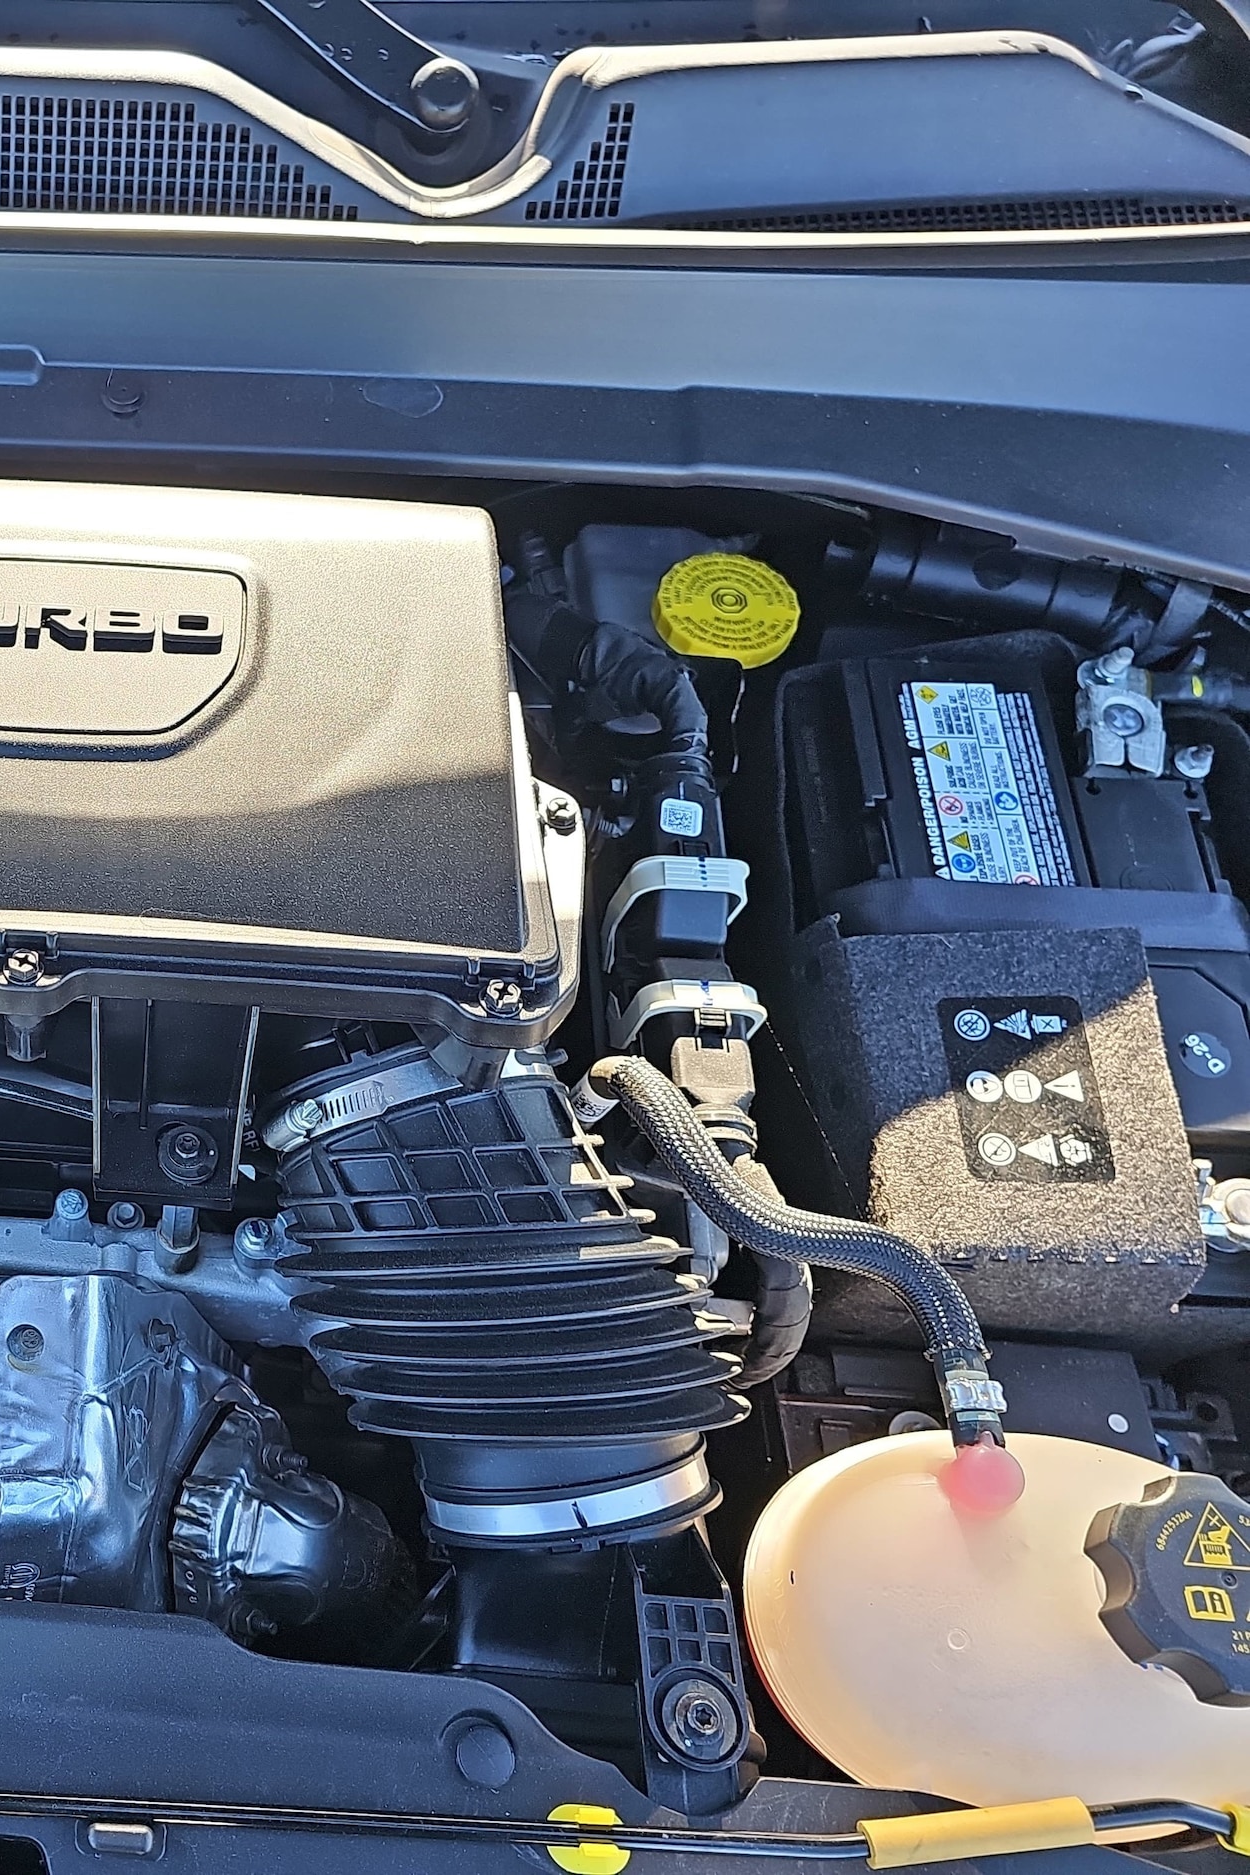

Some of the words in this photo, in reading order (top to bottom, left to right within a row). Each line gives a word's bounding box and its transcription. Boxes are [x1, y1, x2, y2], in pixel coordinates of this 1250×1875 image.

[902, 719, 921, 749] AGM
[910, 756, 946, 865] DANGER/POISON
[1185, 1034, 1226, 1074] D-26
[1155, 1509, 1194, 1551] 68442532AA
